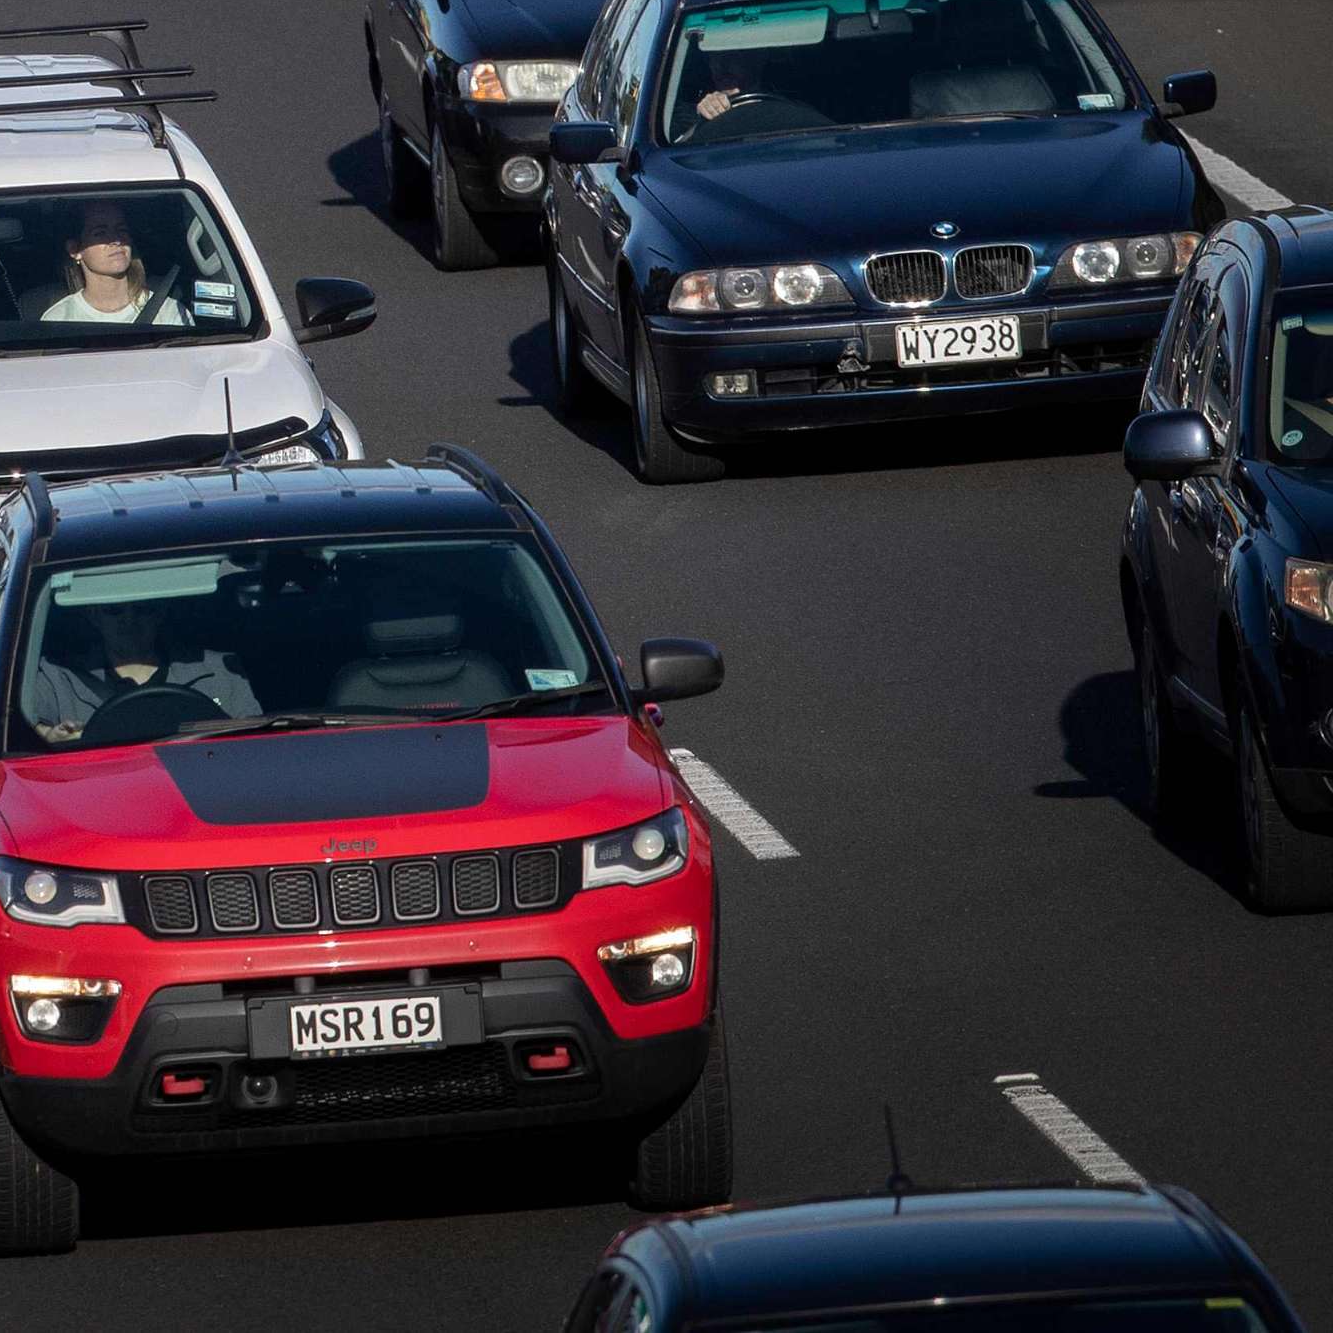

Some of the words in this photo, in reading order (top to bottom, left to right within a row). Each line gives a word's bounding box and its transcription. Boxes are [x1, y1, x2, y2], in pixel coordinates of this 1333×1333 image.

[902, 322, 1015, 360] WY2938
[321, 837, 377, 860] Jeep
[296, 1002, 435, 1045] MSR169
